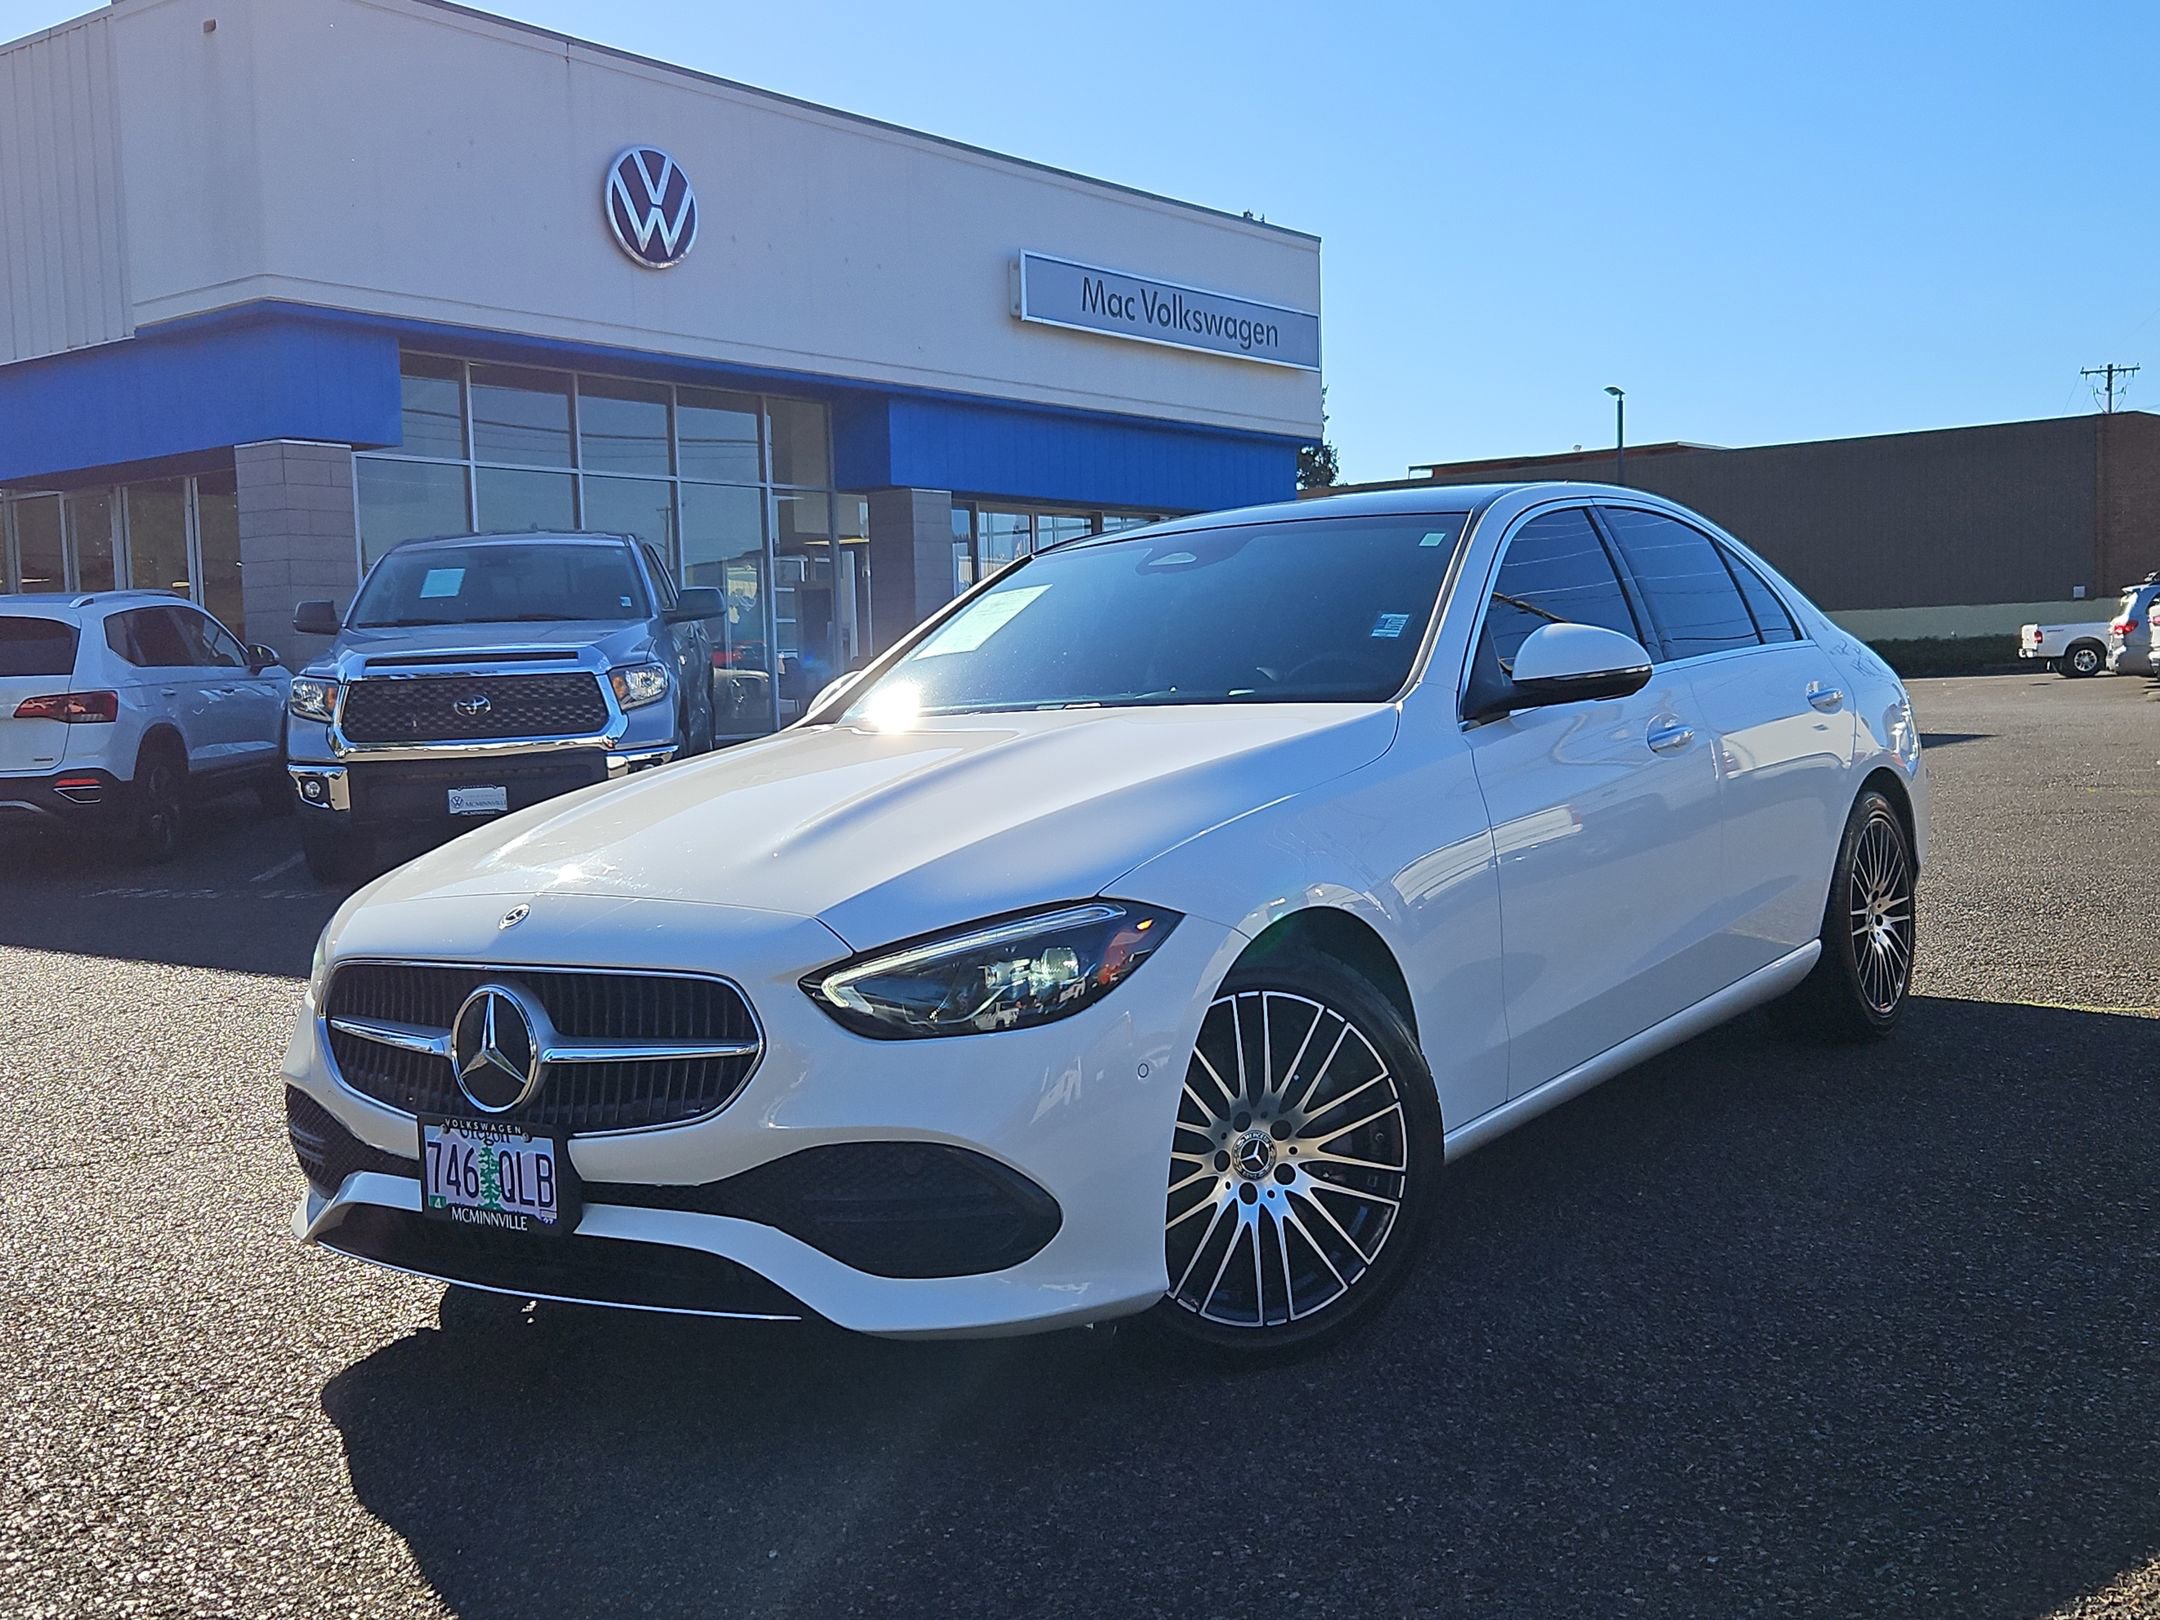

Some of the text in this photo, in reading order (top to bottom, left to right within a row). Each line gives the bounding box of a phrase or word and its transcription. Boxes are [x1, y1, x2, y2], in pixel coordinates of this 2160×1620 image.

[1081, 276, 1279, 350] Mac Volkswagen
[444, 1118, 522, 1135] VOLKSWAGEN
[427, 1141, 555, 1208] 746 QLB
[451, 1206, 528, 1231] MCMINNVILLE
